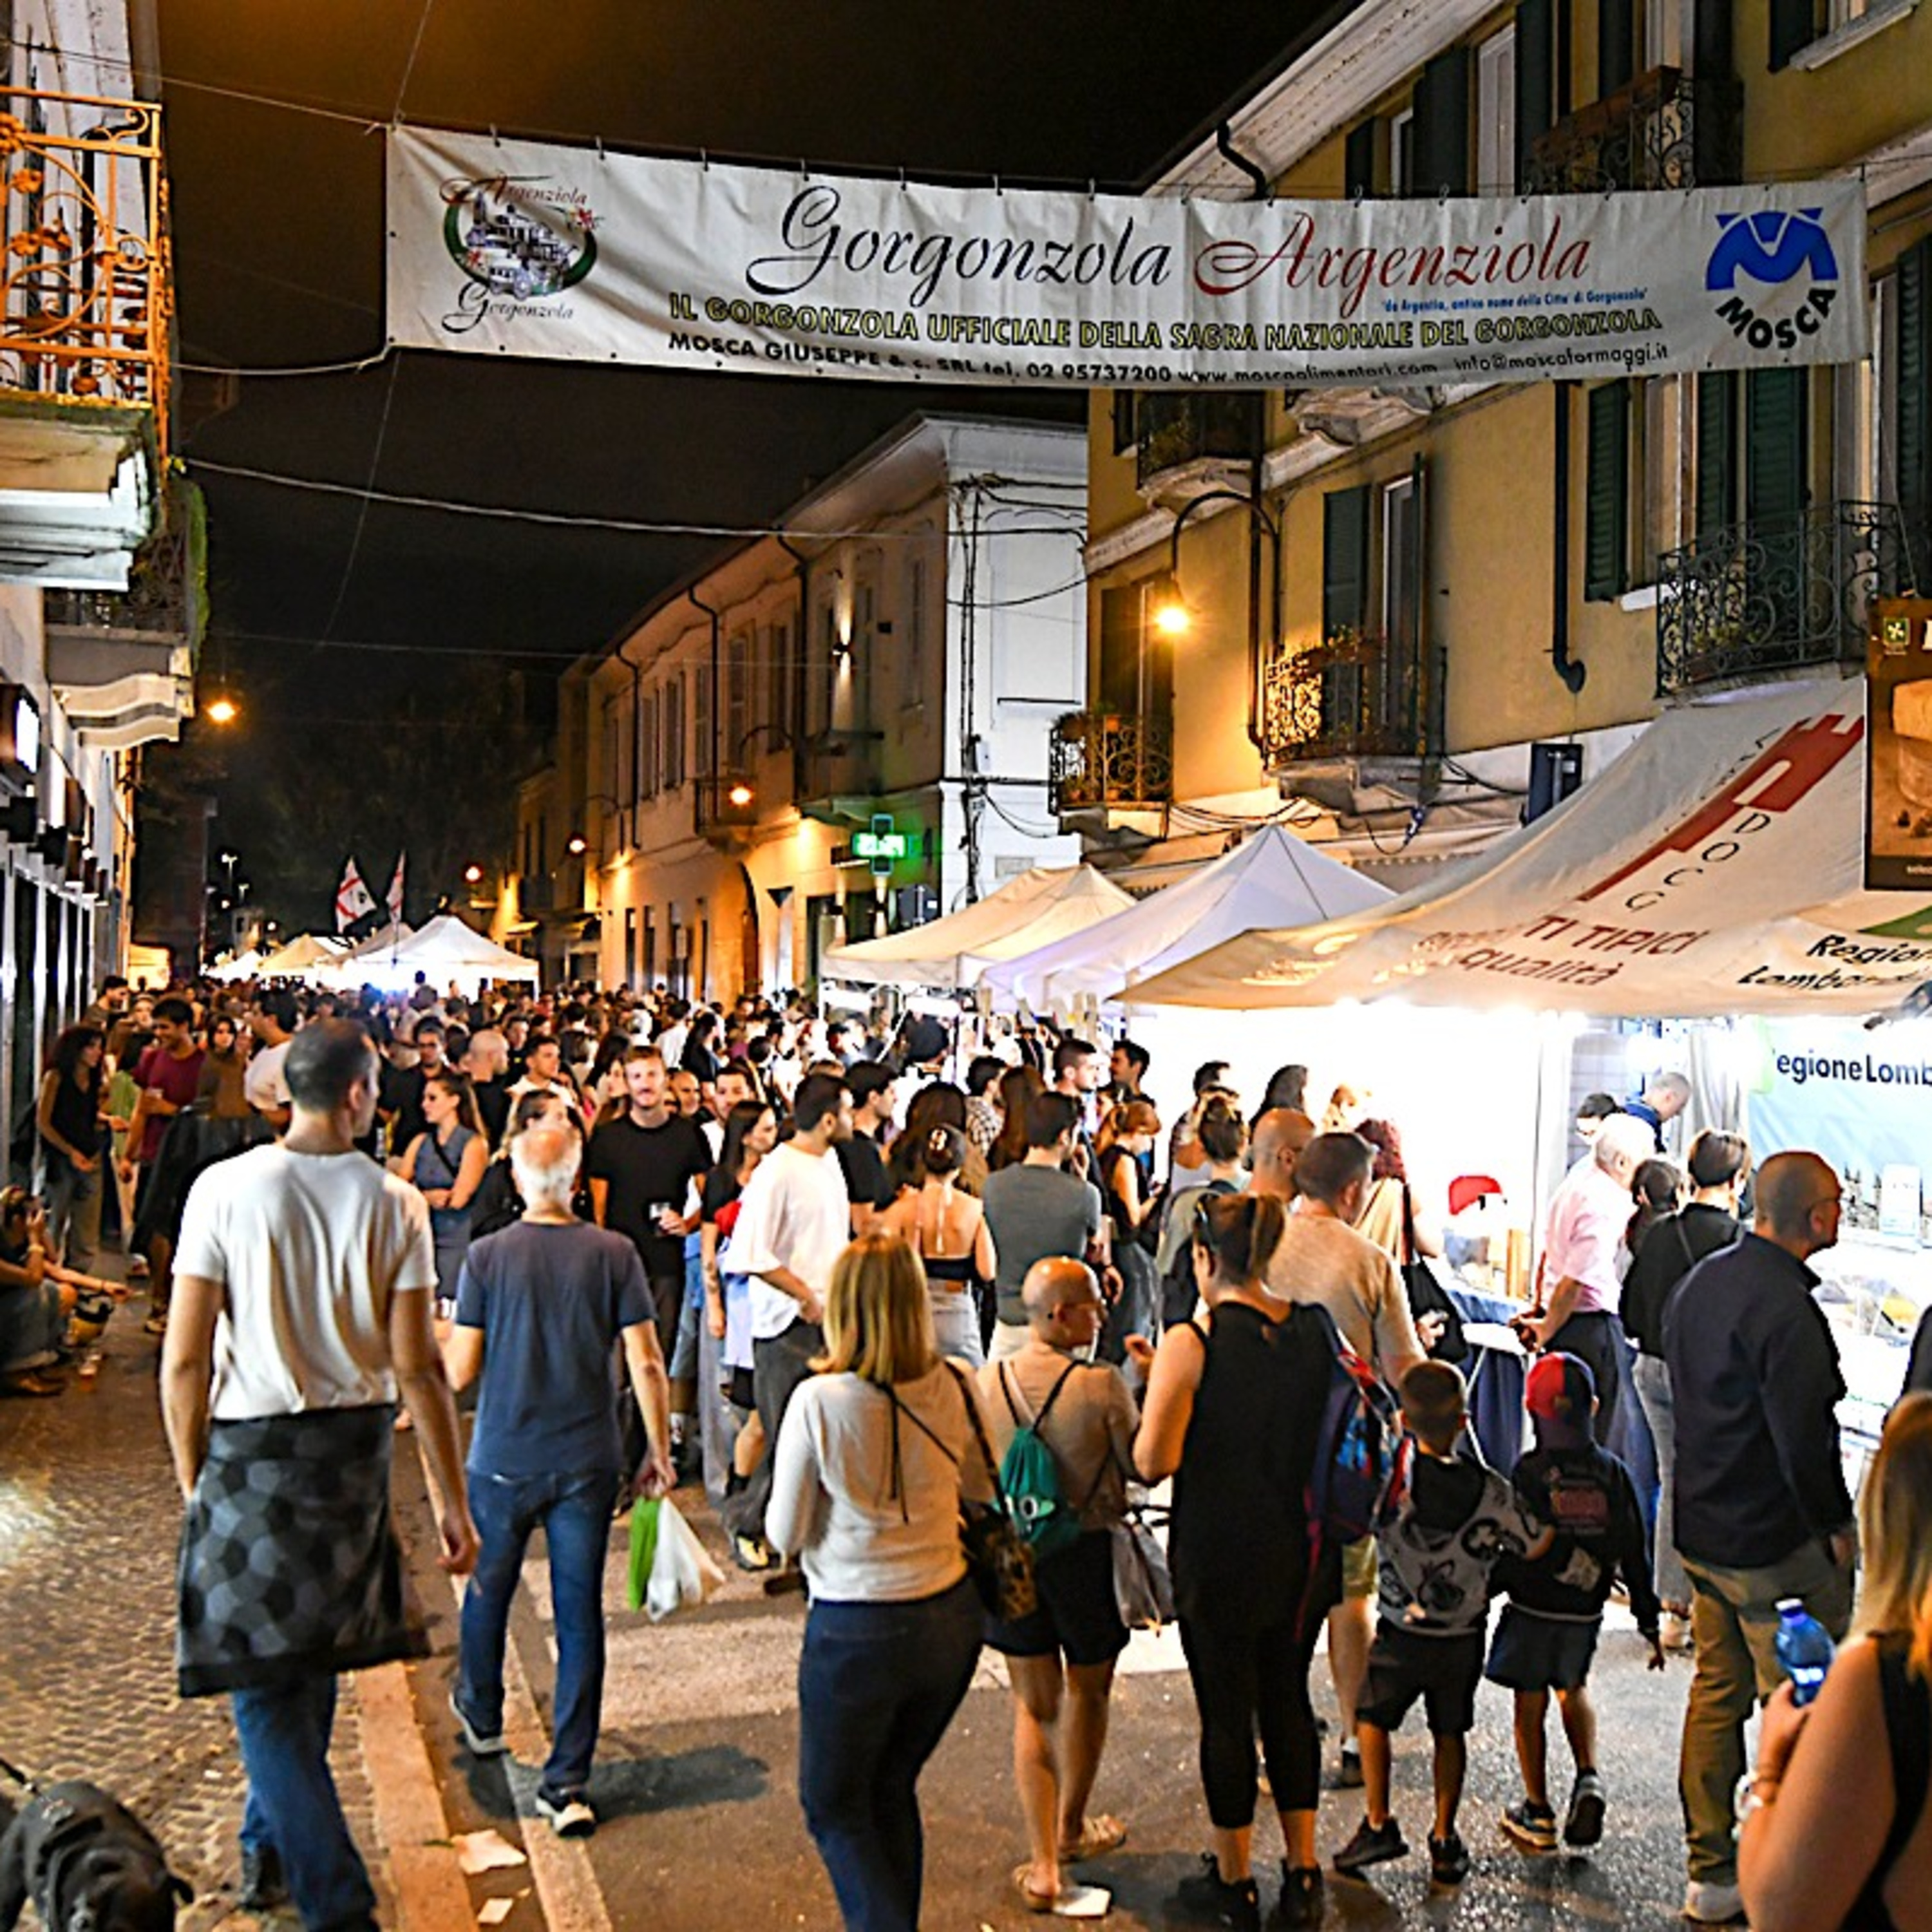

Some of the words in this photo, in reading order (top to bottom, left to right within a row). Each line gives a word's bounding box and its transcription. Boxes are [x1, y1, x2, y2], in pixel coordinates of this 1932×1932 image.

[746, 185, 1171, 308] Gorgonzola
[1193, 211, 1591, 319] Argenziola
[442, 281, 573, 334] Gorgonzola
[668, 292, 697, 321] IL
[705, 296, 918, 341] GORGONZOLA
[926, 313, 1070, 348] UFFICIALE
[1079, 320, 1163, 348] DELLA
[1170, 321, 1258, 350] SAGRA
[1265, 321, 1414, 350] NAZIONALE
[1421, 319, 1468, 348] DEL
[1475, 308, 1663, 343] GORGONZOLA
[1715, 288, 1837, 348] MOSCA
[668, 332, 756, 356] MOSCA
[764, 341, 880, 366] GIUSEPPE
[937, 358, 978, 373] SRL
[1027, 362, 1054, 379] 02
[1062, 363, 1171, 383] 95737200
[1454, 343, 1667, 371] info@moscaformaggi.it
[1571, 925, 1710, 954] TIPICI
[1458, 949, 1624, 986] qualità
